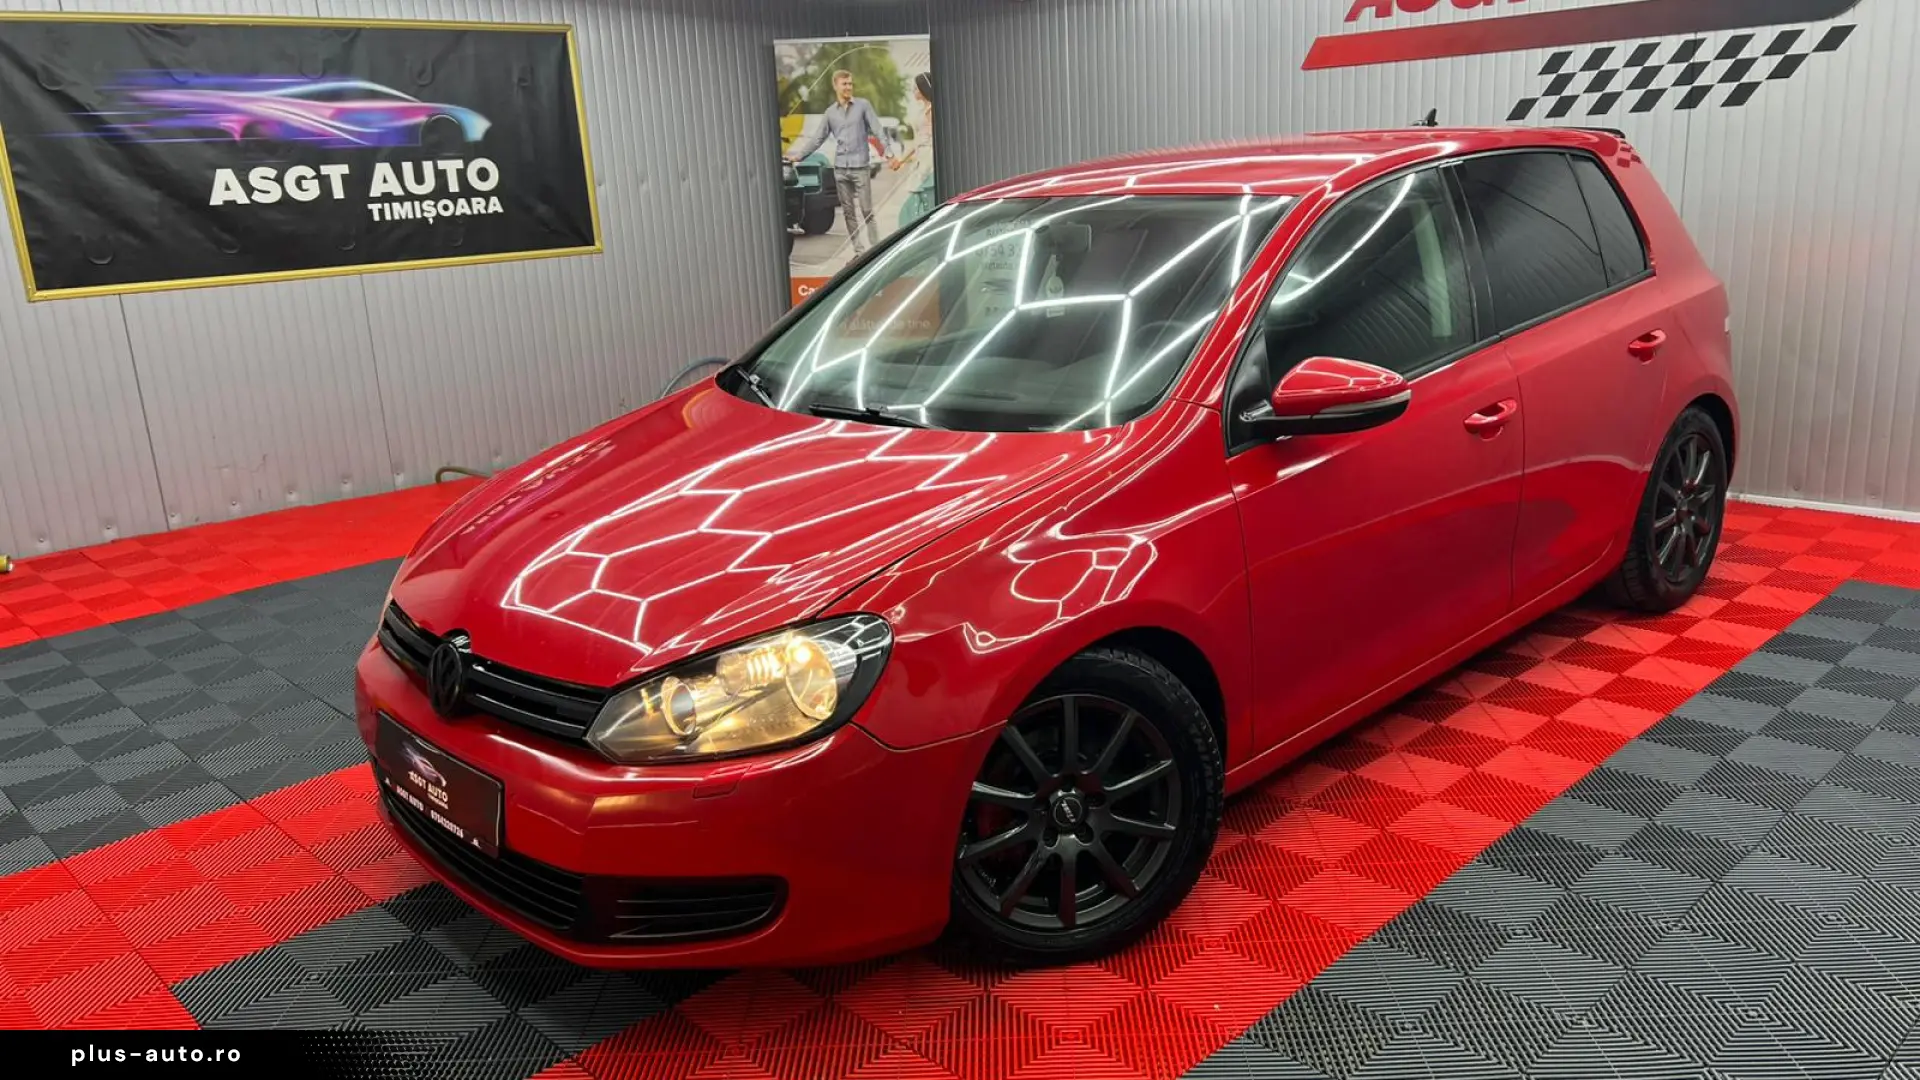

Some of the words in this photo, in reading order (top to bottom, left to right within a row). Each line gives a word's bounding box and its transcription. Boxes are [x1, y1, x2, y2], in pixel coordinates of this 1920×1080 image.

[209, 164, 350, 206] ASGT
[369, 158, 500, 197] AUTO
[367, 196, 504, 224] TIMIȘOARA
[427, 783, 449, 802] AUTO
